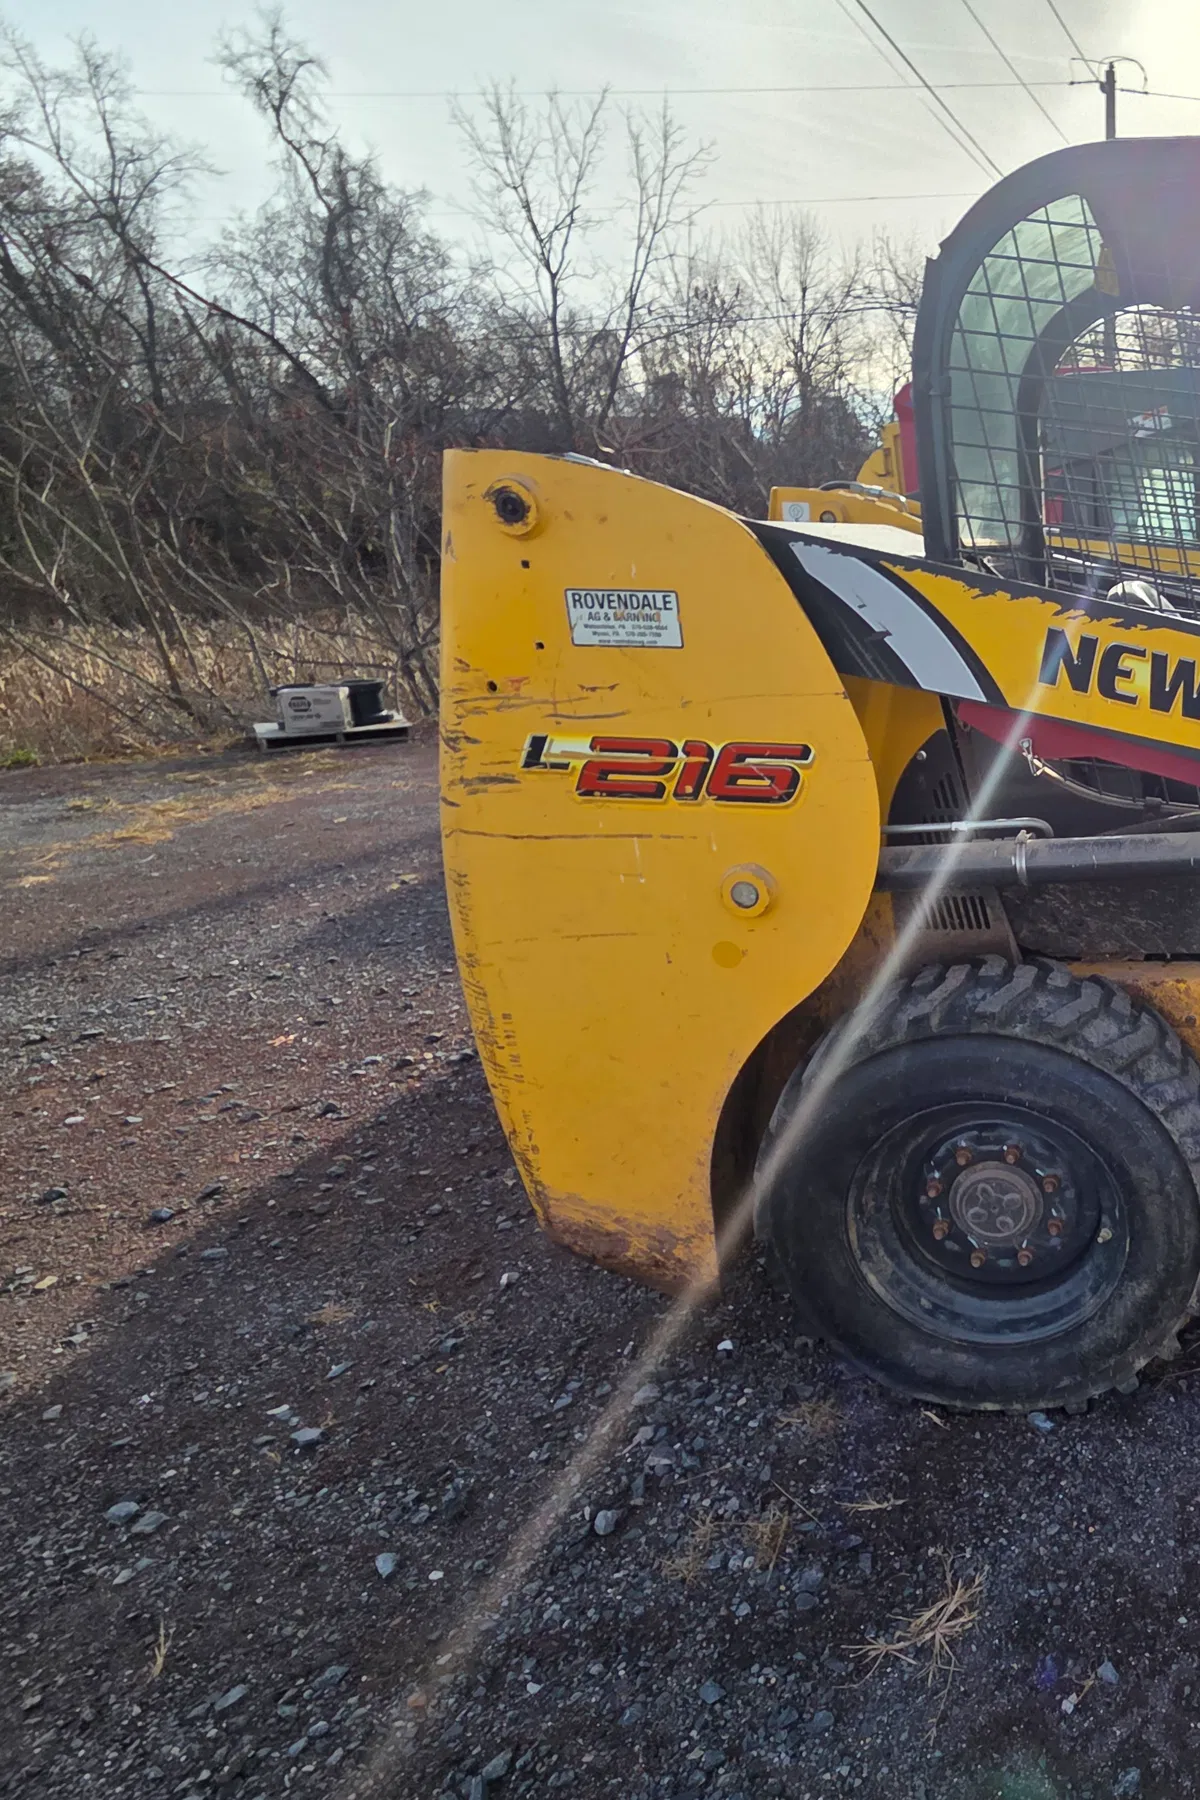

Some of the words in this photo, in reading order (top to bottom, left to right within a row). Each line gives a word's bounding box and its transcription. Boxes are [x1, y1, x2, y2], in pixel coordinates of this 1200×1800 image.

[571, 592, 673, 611] ROVENDALE
[588, 611, 601, 621] AG
[603, 612, 611, 621] &
